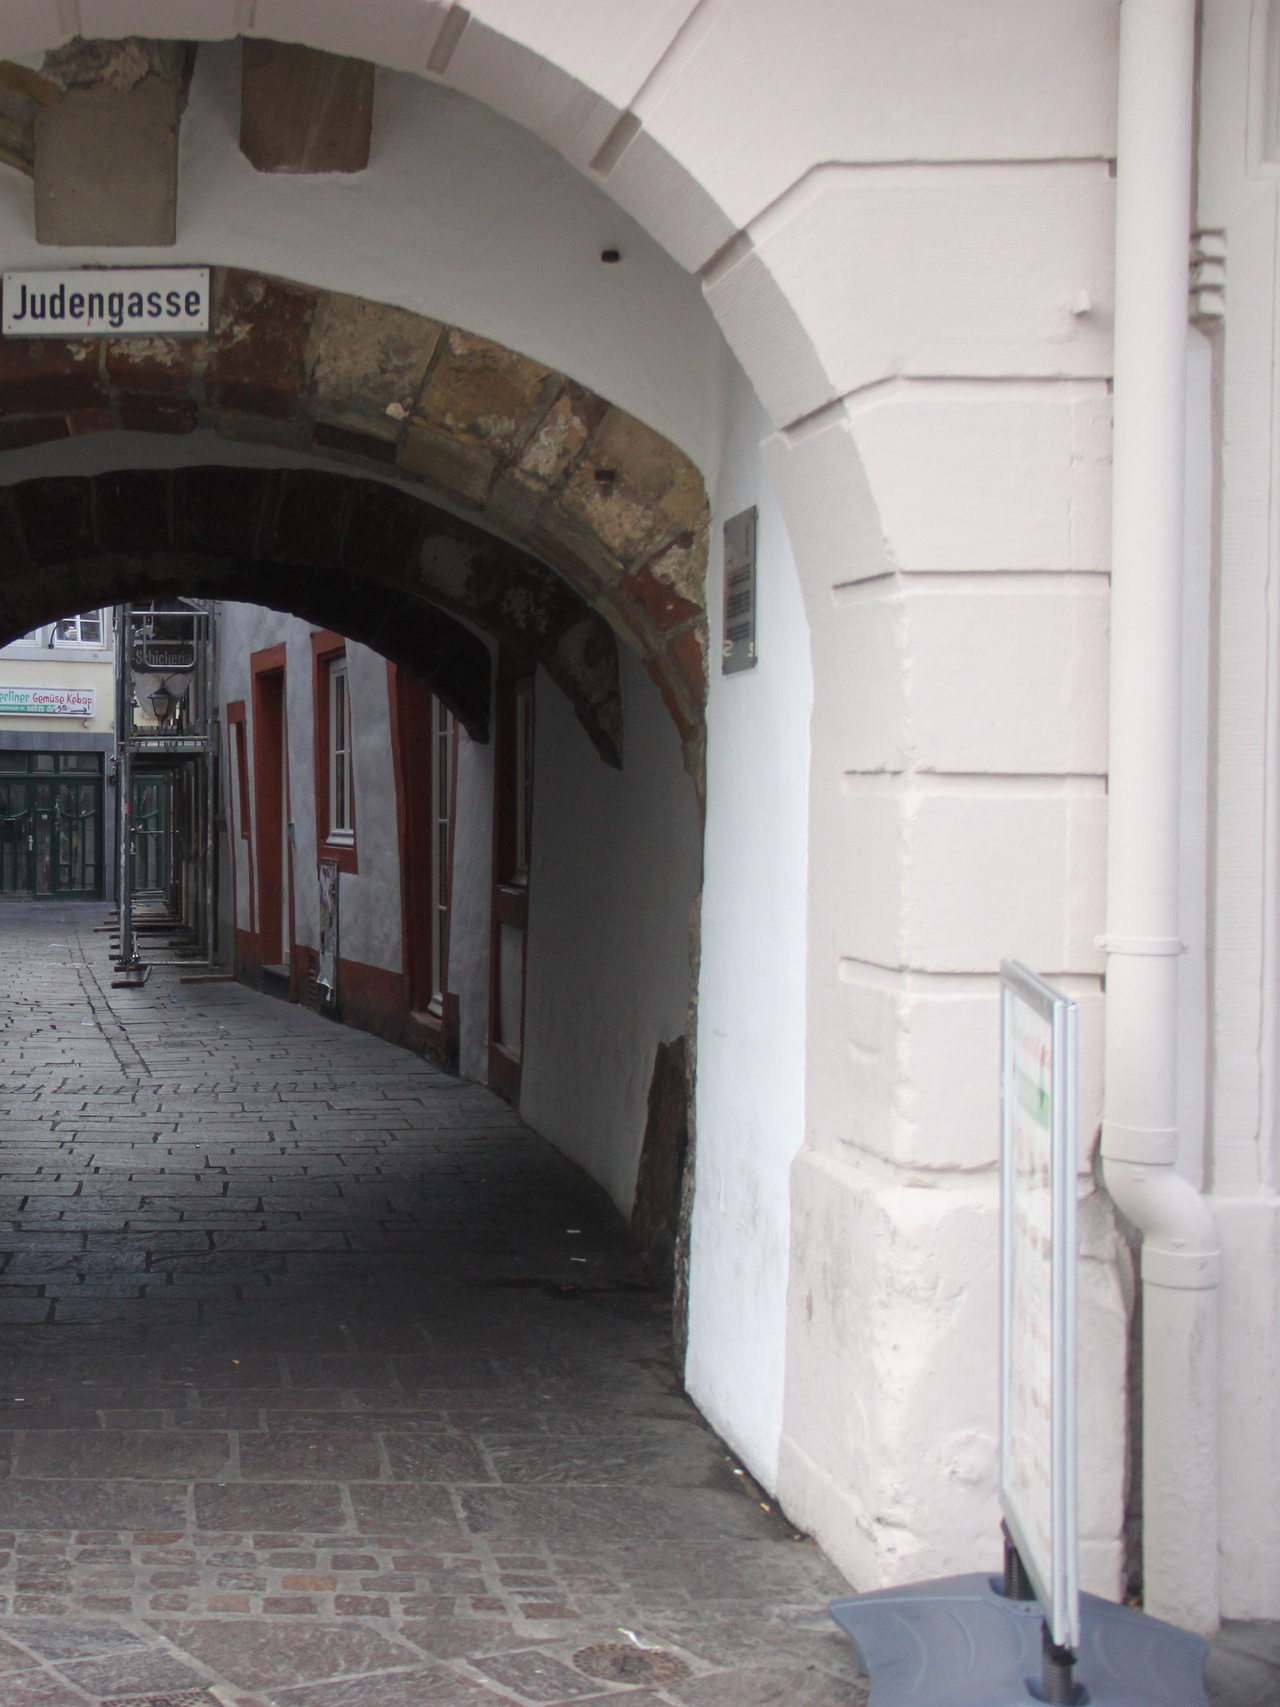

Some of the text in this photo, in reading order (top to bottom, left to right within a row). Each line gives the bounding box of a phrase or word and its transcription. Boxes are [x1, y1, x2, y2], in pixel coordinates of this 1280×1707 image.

[12, 284, 201, 328] Judengasse
[32, 692, 65, 704] Gemüse
[66, 693, 93, 710] Kebap
